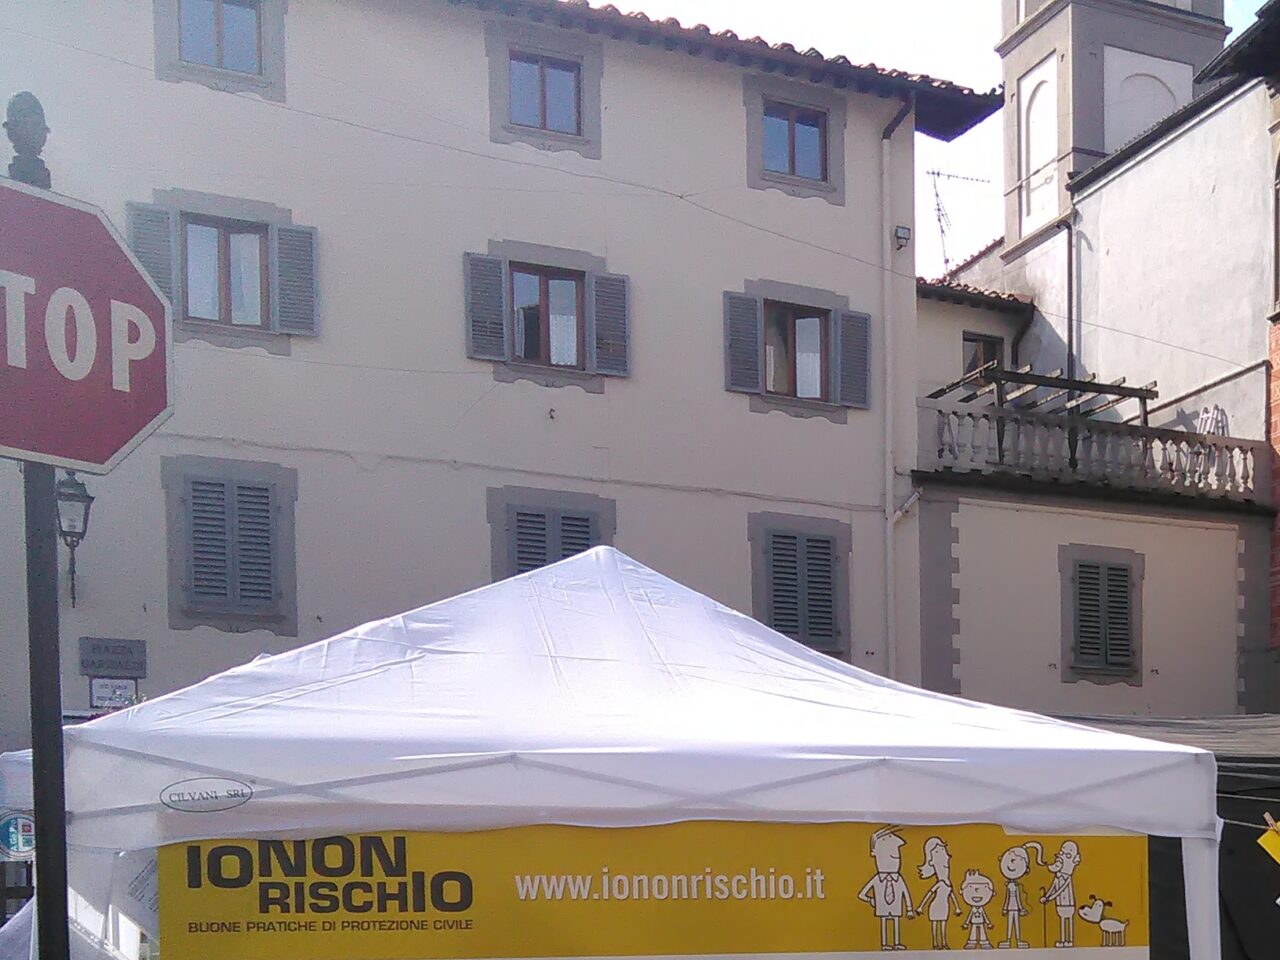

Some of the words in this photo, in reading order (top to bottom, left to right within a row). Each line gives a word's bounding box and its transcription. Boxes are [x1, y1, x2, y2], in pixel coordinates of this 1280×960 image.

[169, 790, 219, 803] CILVANI
[226, 788, 248, 799] SRL
[186, 845, 254, 889] IO
[257, 835, 407, 878] NON
[258, 871, 474, 914] RISCHIO
[515, 867, 826, 901] www.iononrischio.it
[188, 921, 241, 933] BUONE
[246, 920, 317, 932] PRATICHE
[322, 921, 336, 931] DI
[341, 919, 429, 931] PROTEZIONE
[433, 919, 474, 930] CIVILE
